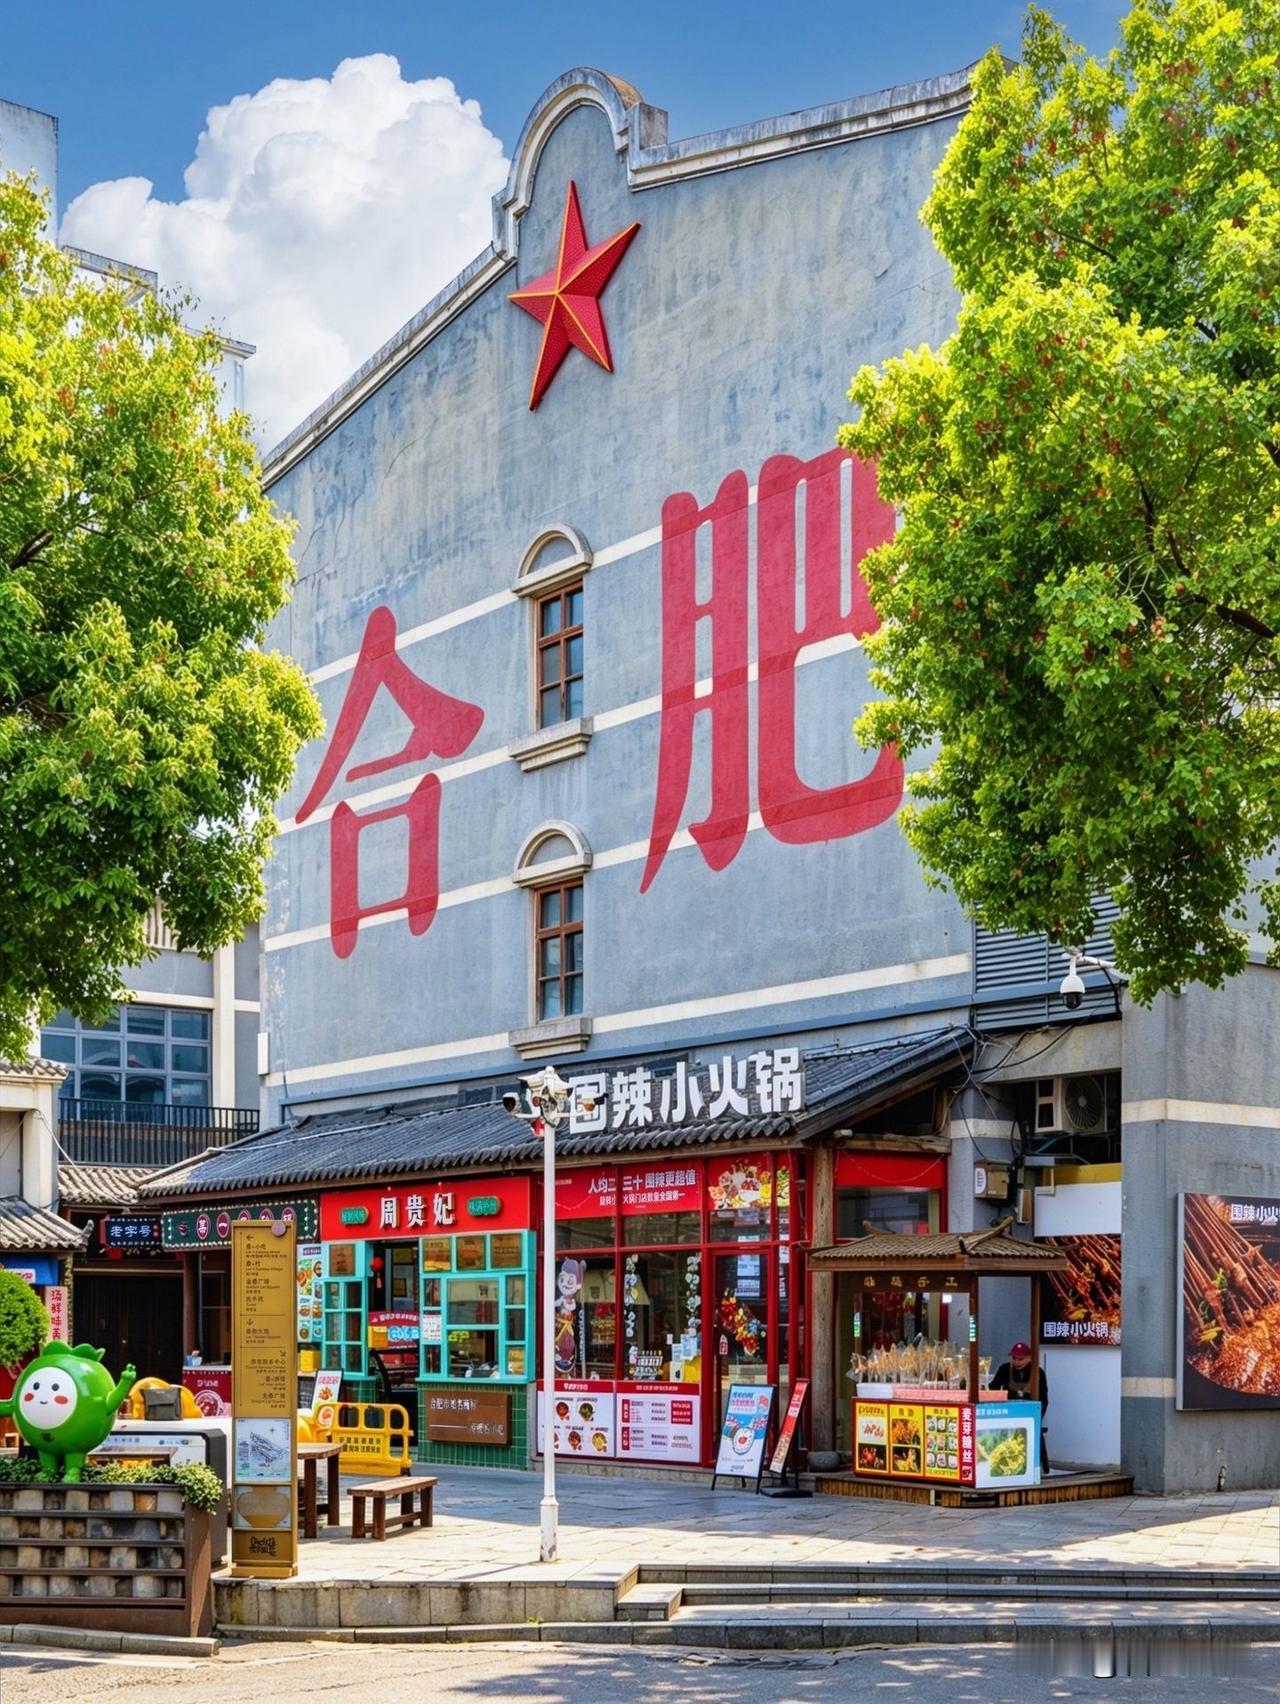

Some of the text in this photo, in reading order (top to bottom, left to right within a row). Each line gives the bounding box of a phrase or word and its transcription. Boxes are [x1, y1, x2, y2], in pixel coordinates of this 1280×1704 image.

[295, 448, 905, 959] 合肥
[380, 1193, 455, 1229] 周贵妃
[1231, 1203, 1280, 1222] 围辣小火
[110, 1225, 152, 1238] 老字号
[1043, 1321, 1109, 1338] 围辣小火锅
